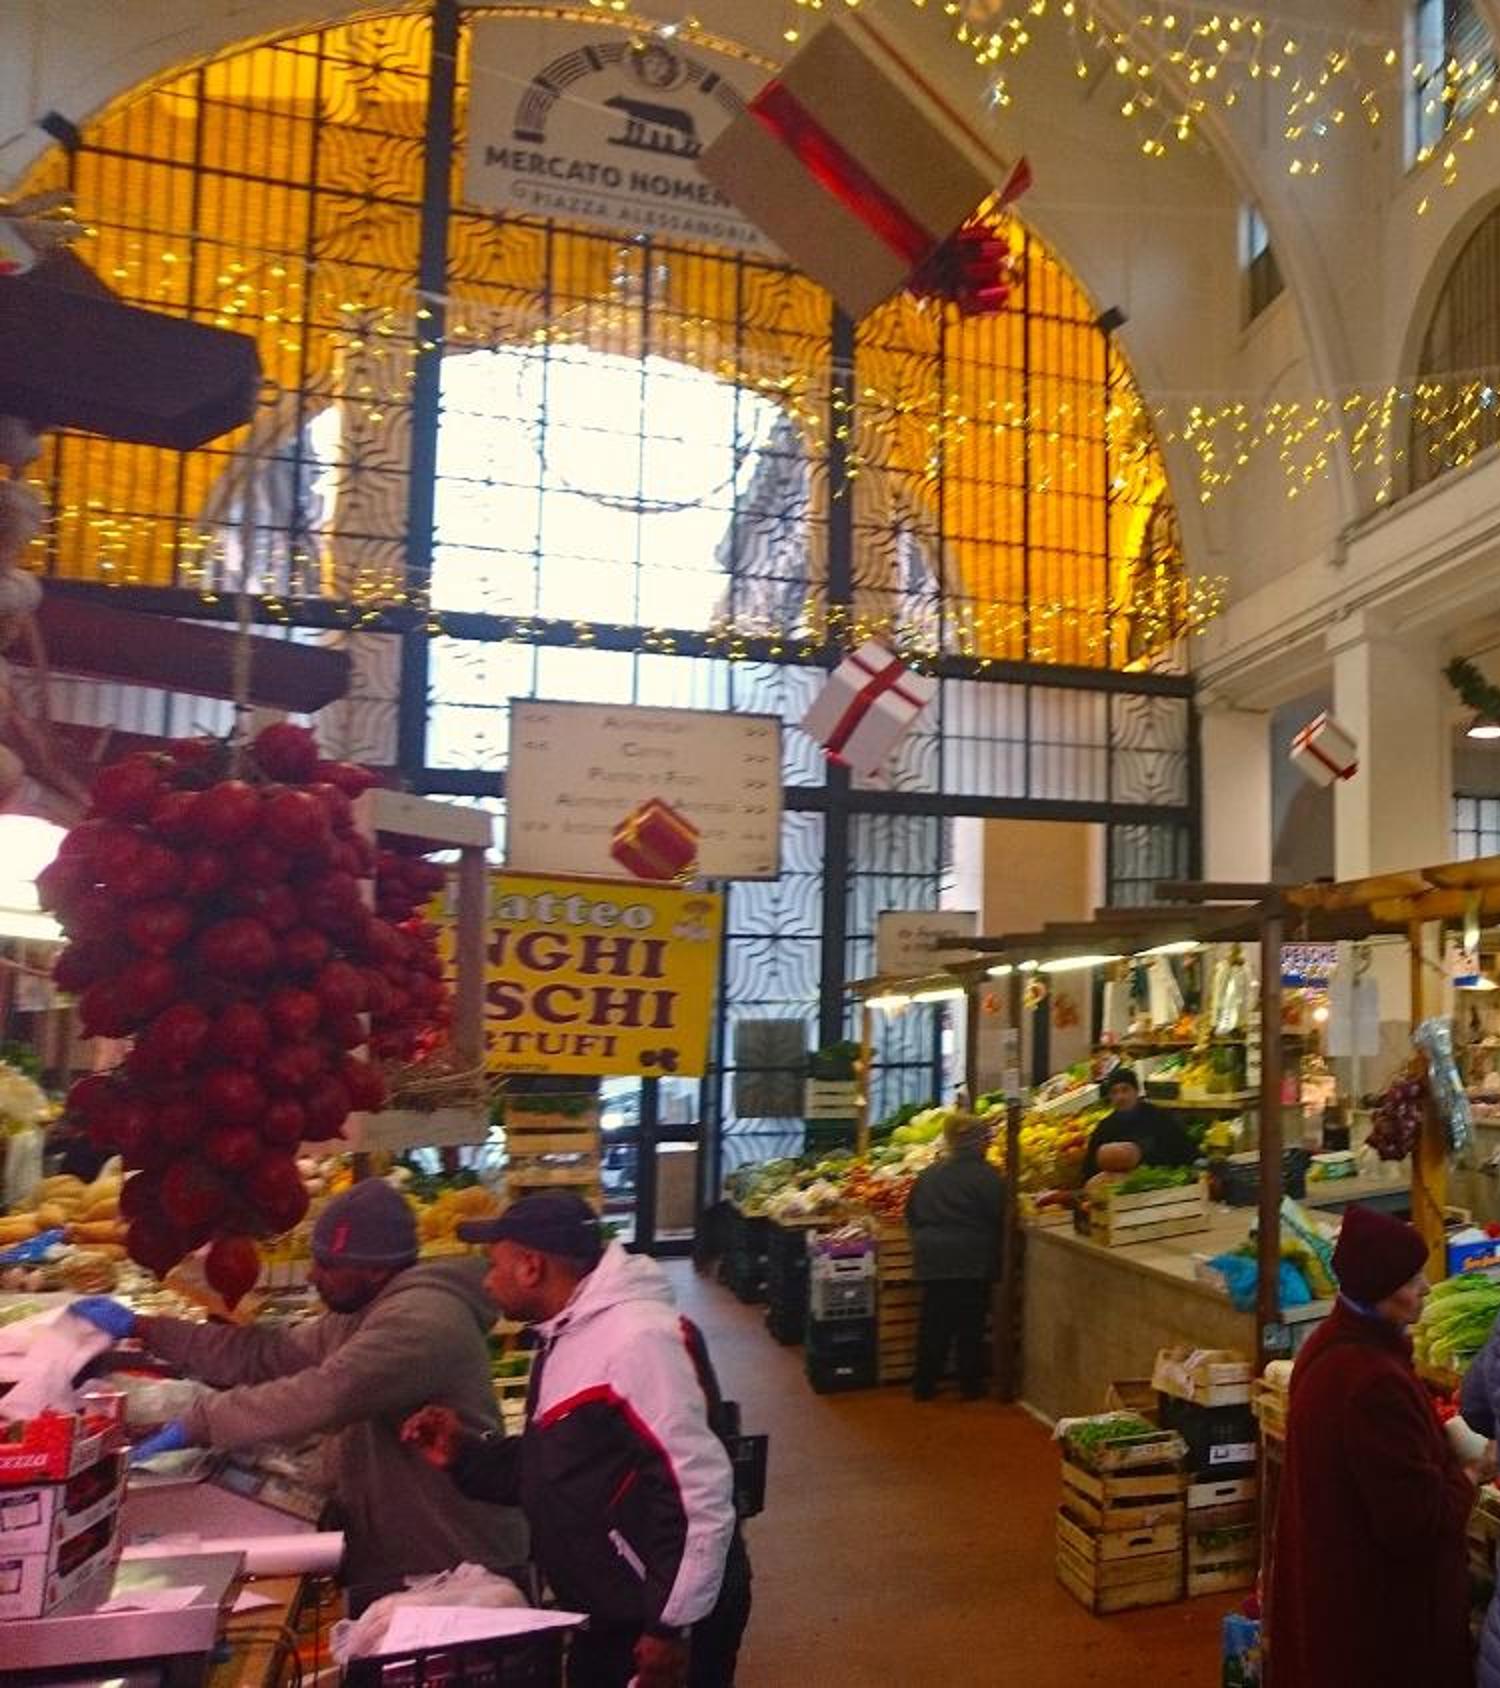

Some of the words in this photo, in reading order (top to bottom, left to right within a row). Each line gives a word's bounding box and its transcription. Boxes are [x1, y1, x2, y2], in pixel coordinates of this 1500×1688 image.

[484, 145, 622, 189] MERCATO
[532, 191, 610, 219] PIAZZA
[618, 207, 760, 244] ALESSANDRIA
